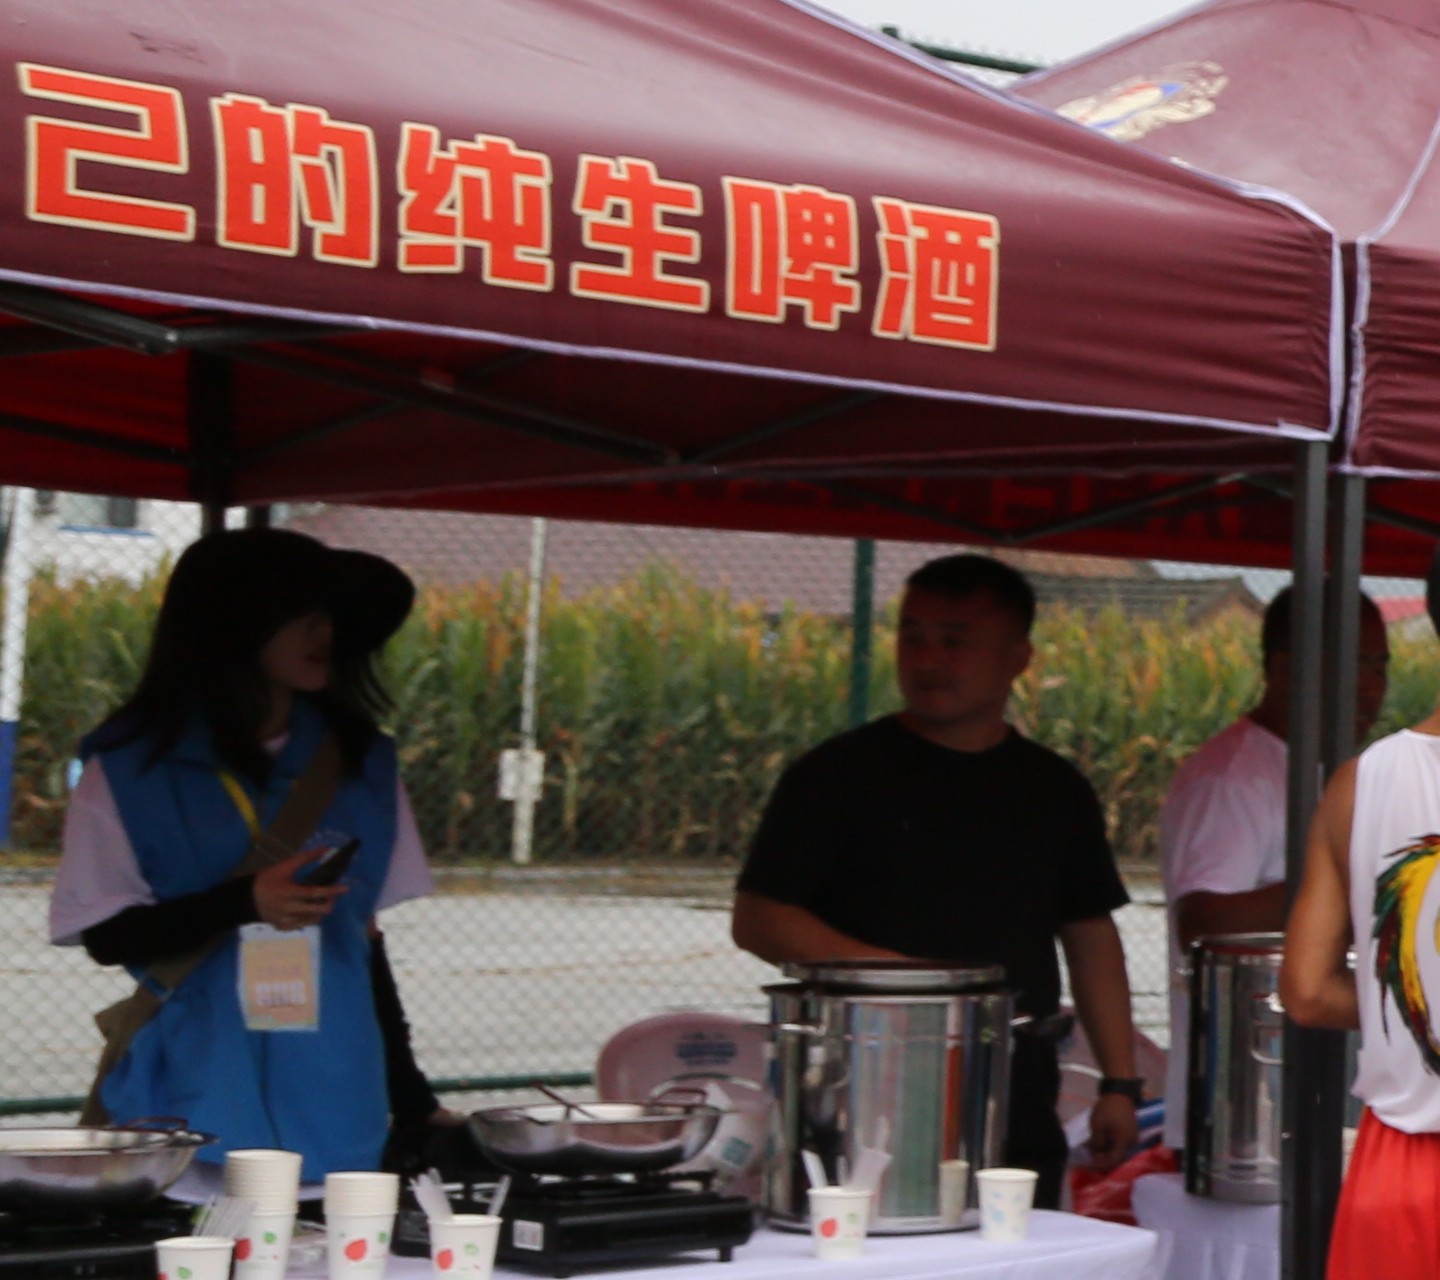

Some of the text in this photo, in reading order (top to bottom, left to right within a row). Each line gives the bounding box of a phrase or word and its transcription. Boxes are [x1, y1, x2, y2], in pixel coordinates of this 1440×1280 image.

[16, 63, 1001, 352] 己的纯生啤酒
